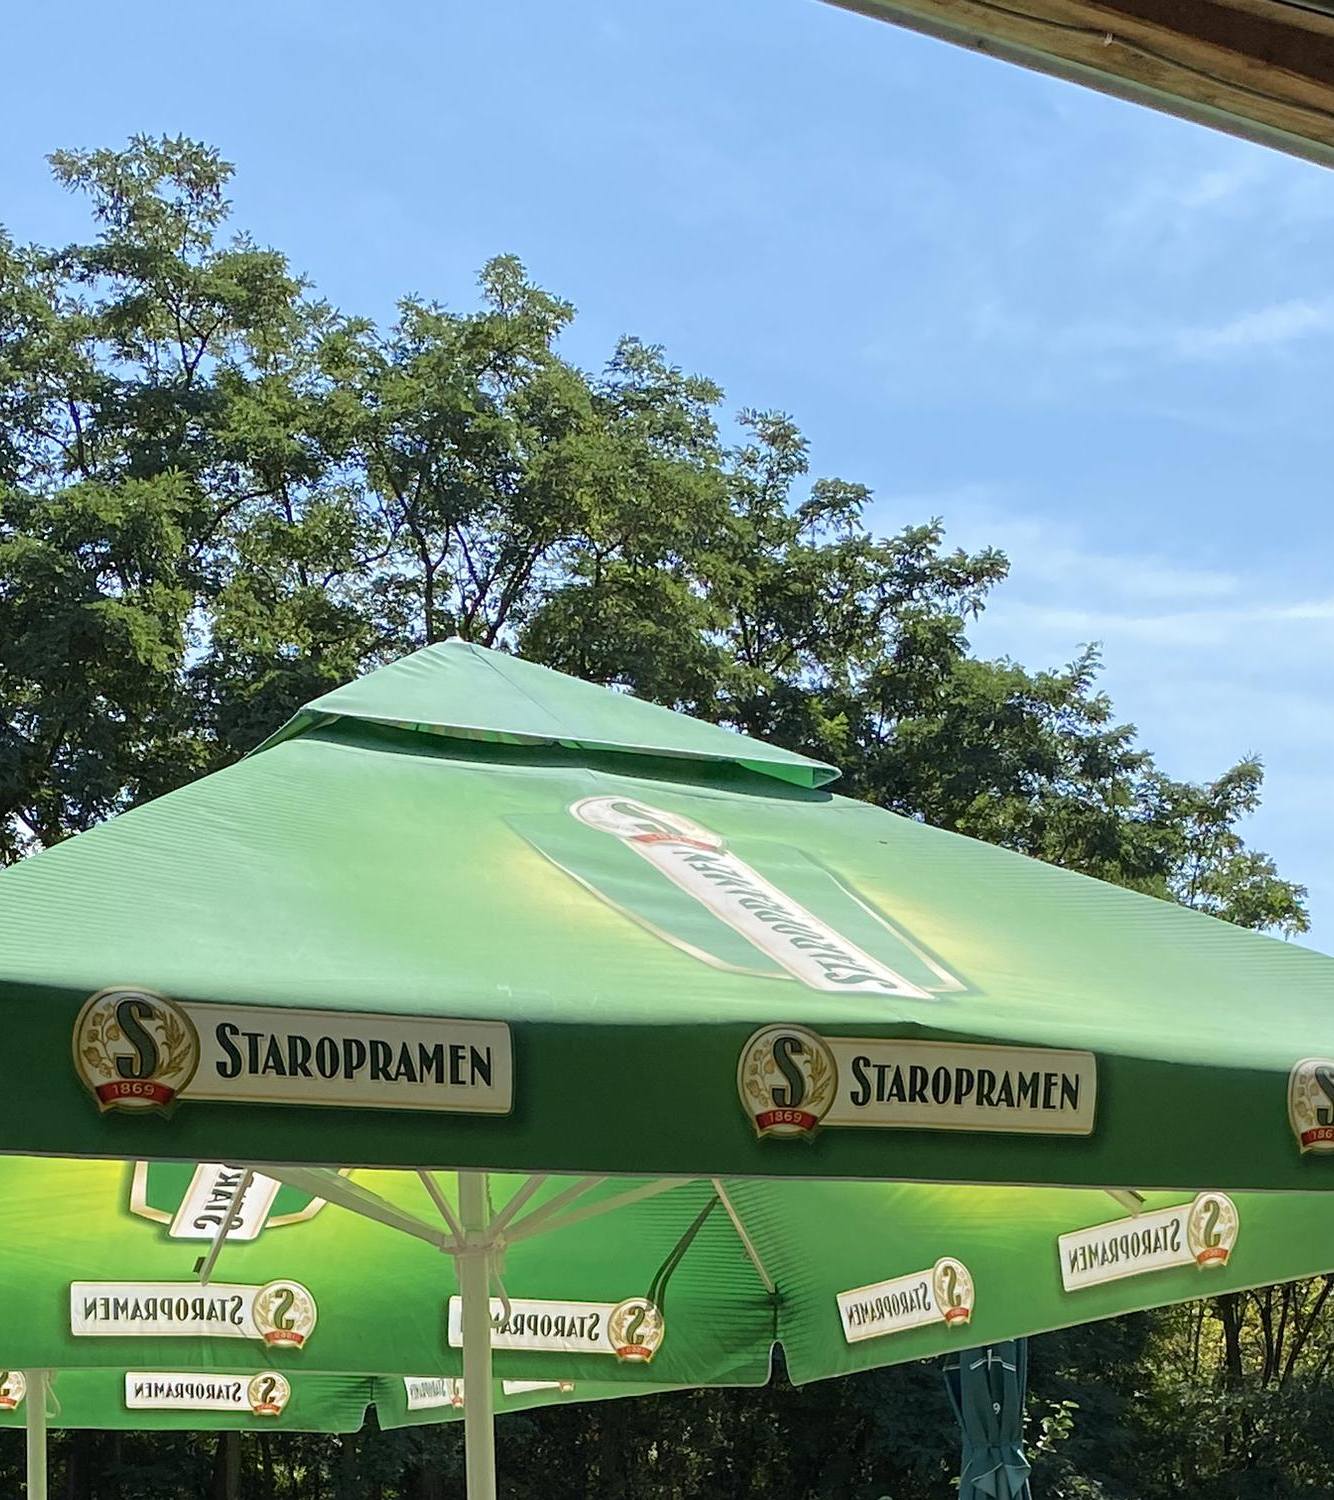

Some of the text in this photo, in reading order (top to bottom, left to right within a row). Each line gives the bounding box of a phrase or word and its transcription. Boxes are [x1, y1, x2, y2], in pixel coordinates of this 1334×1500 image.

[114, 1000, 160, 1080] S
[215, 1022, 493, 1088] STAROPRAMEN
[112, 1081, 155, 1098] 1869
[771, 1036, 806, 1108] S
[849, 1056, 1080, 1111] STAROPRAMEN
[767, 1110, 803, 1124] 1869
